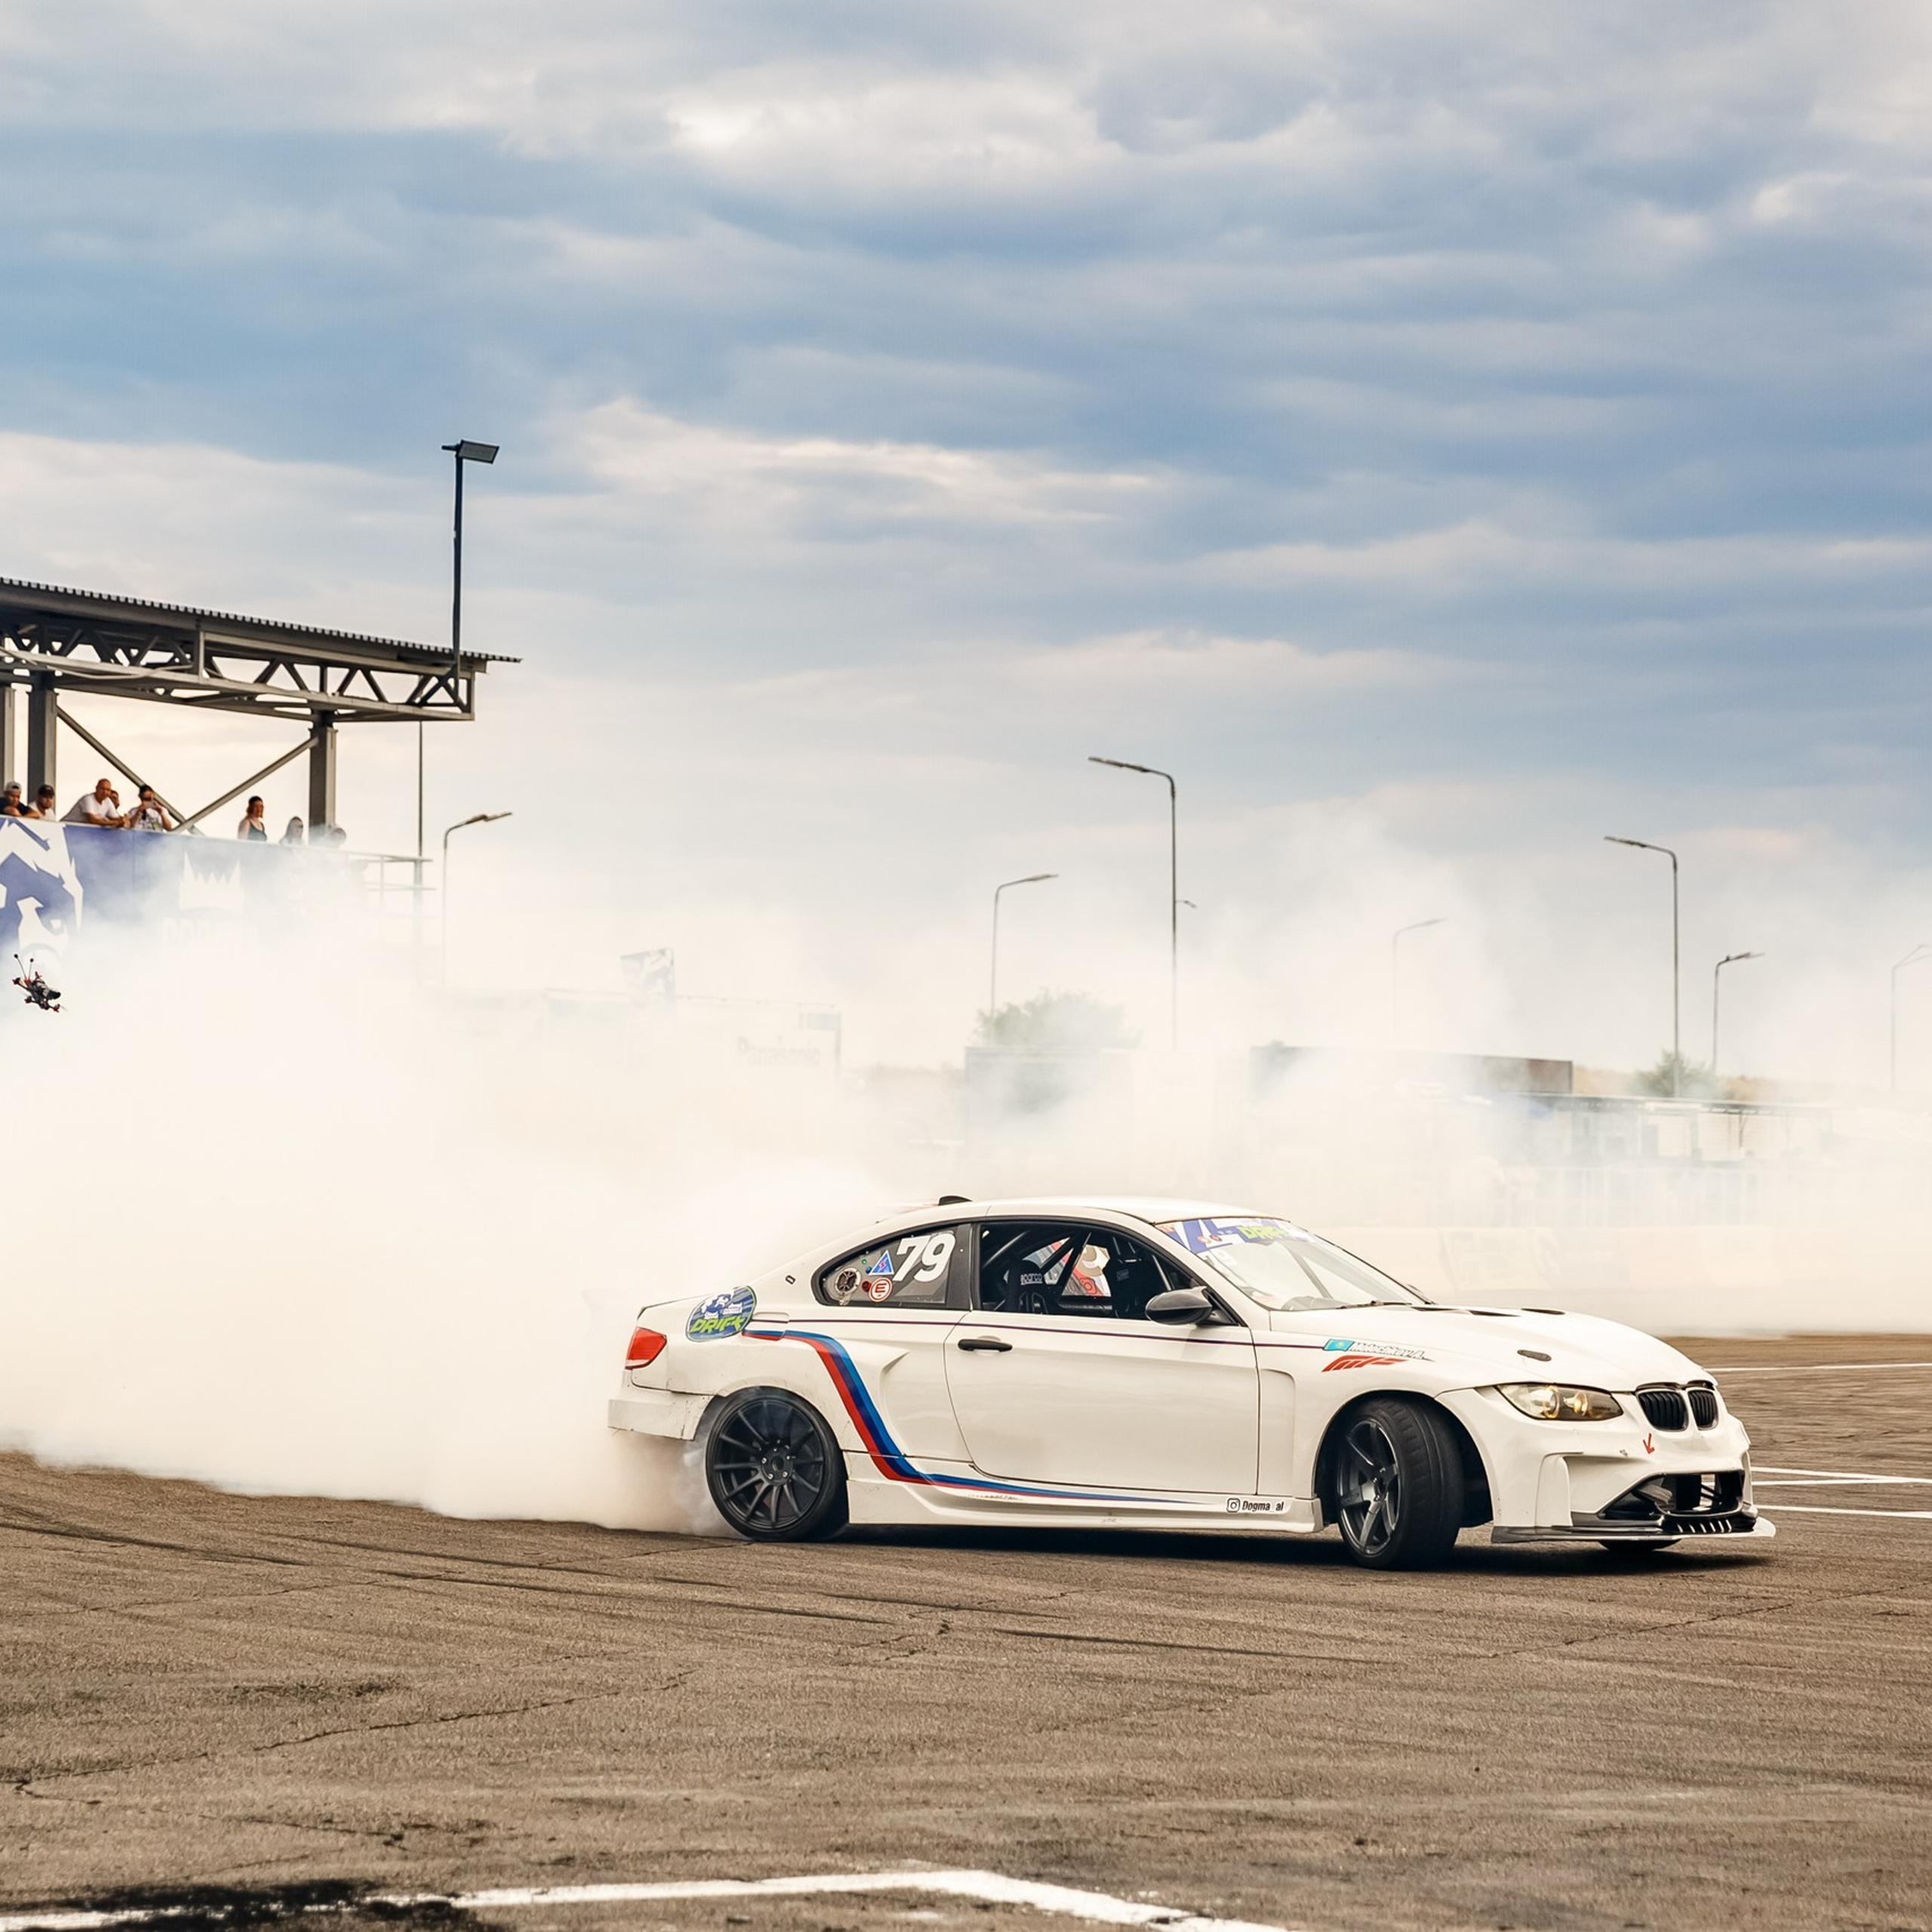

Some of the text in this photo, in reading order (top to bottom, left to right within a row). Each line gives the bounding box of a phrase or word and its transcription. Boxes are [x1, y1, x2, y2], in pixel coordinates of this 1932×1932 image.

[893, 1233, 957, 1282] 79
[875, 1283, 887, 1294] E
[689, 1316, 746, 1334] DRIFT
